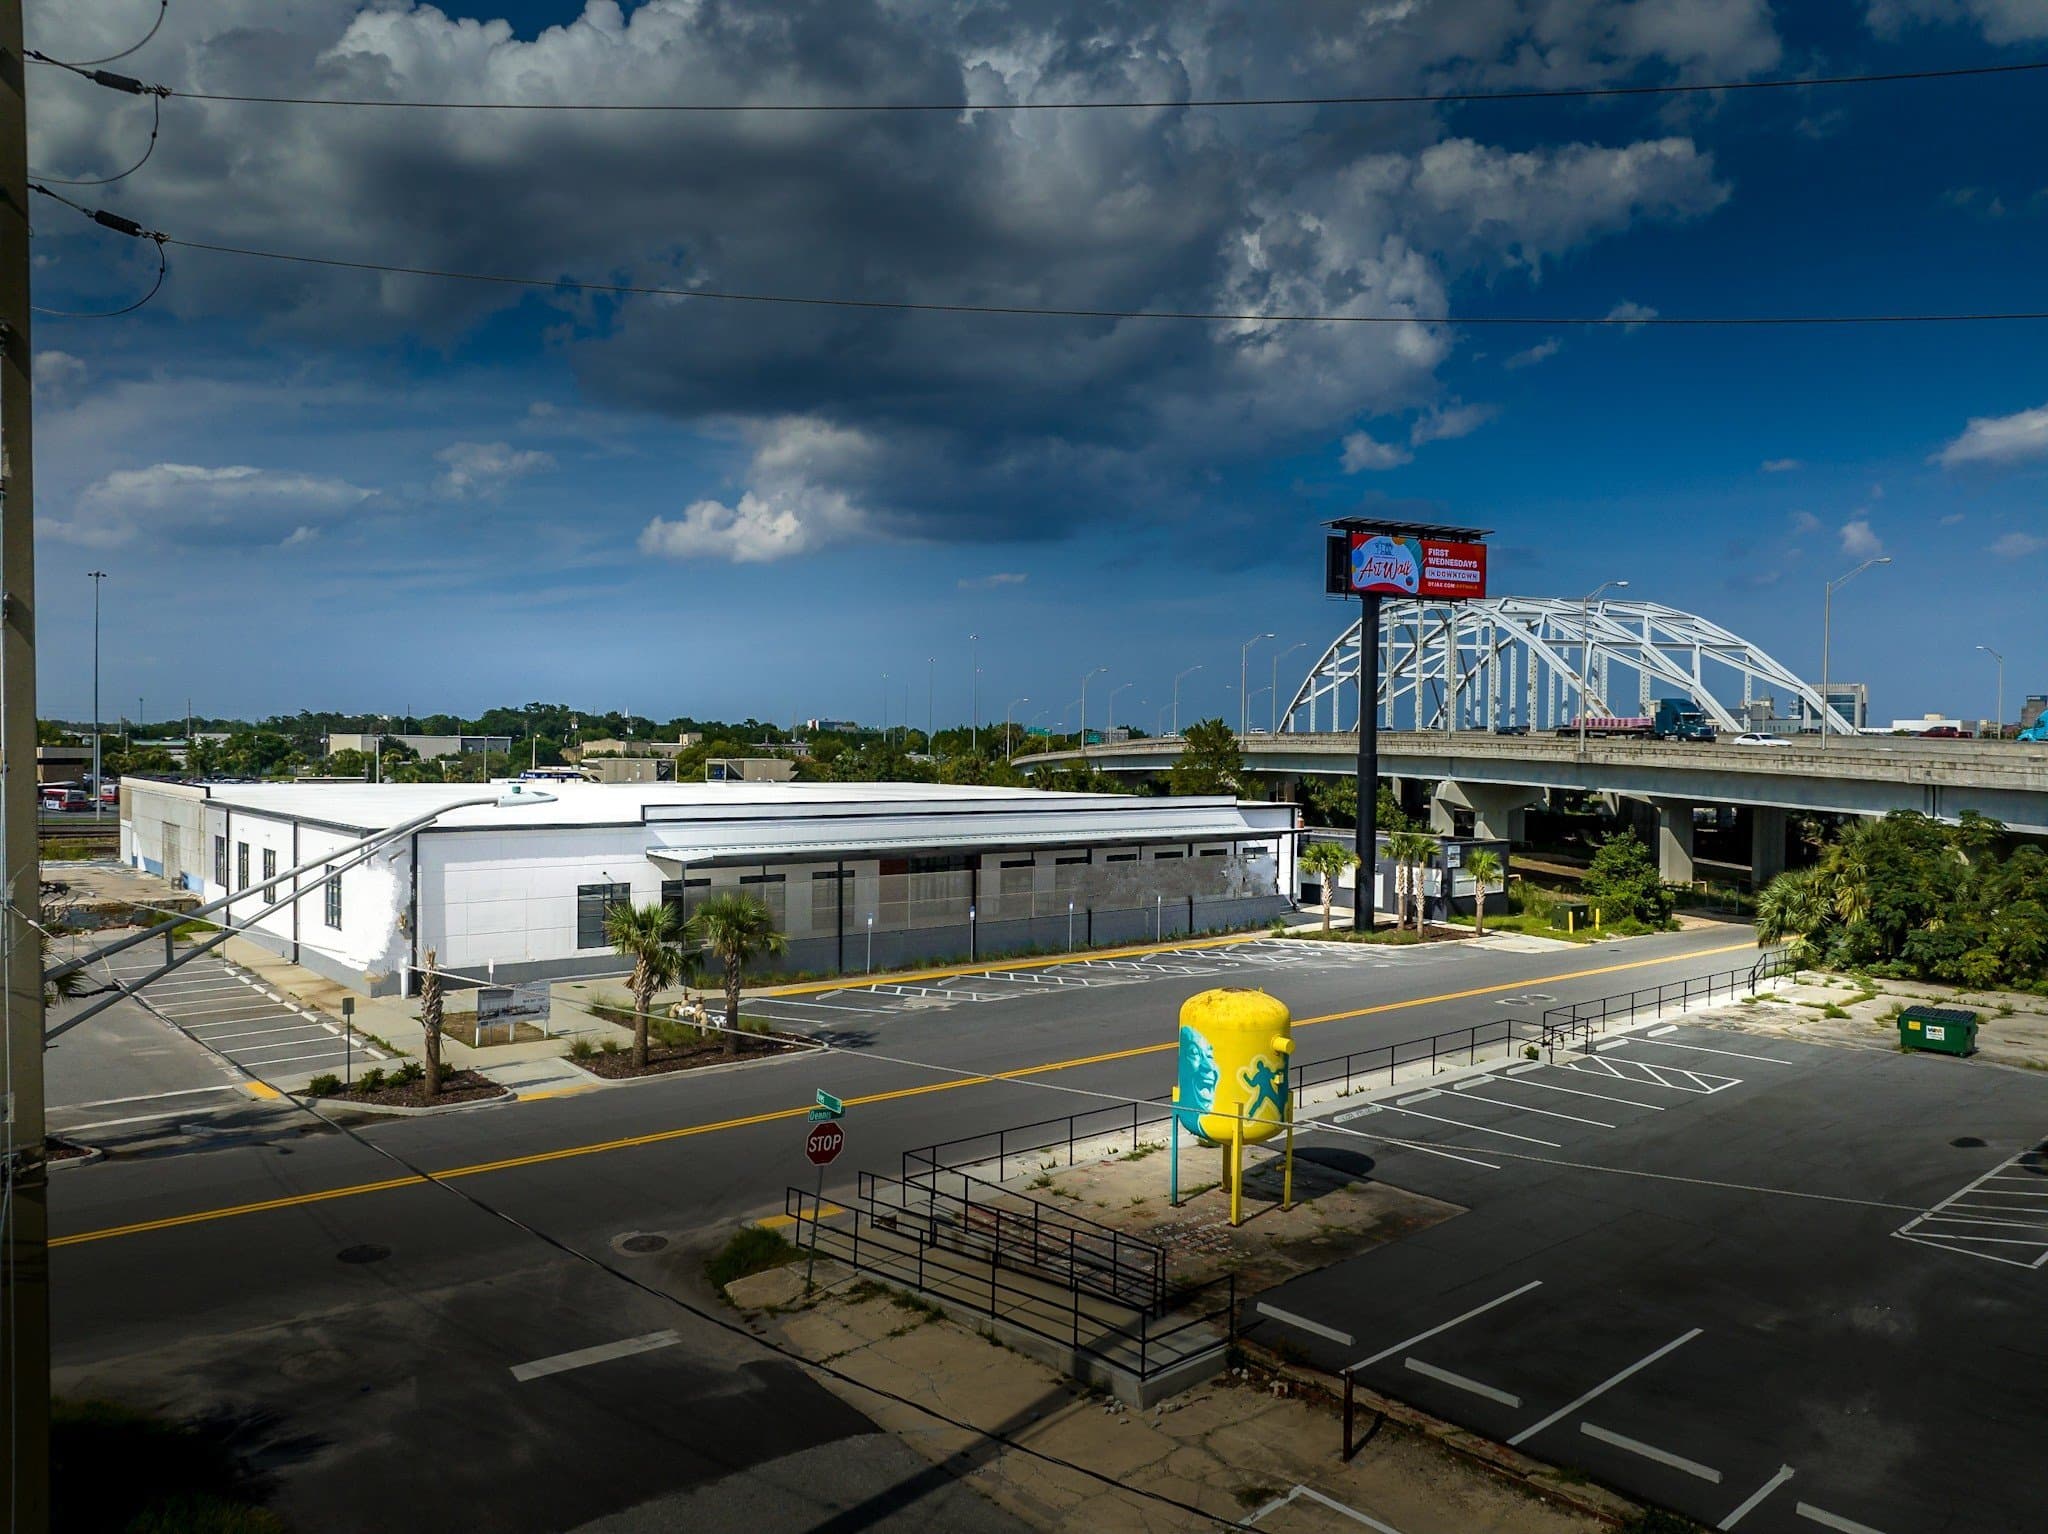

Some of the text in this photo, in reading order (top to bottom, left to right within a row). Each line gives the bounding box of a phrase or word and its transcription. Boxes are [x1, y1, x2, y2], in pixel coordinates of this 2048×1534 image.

[1428, 548, 1449, 557] FIRST
[1428, 557, 1477, 568] WEDNESDAYS
[809, 1134, 841, 1152] STOP
